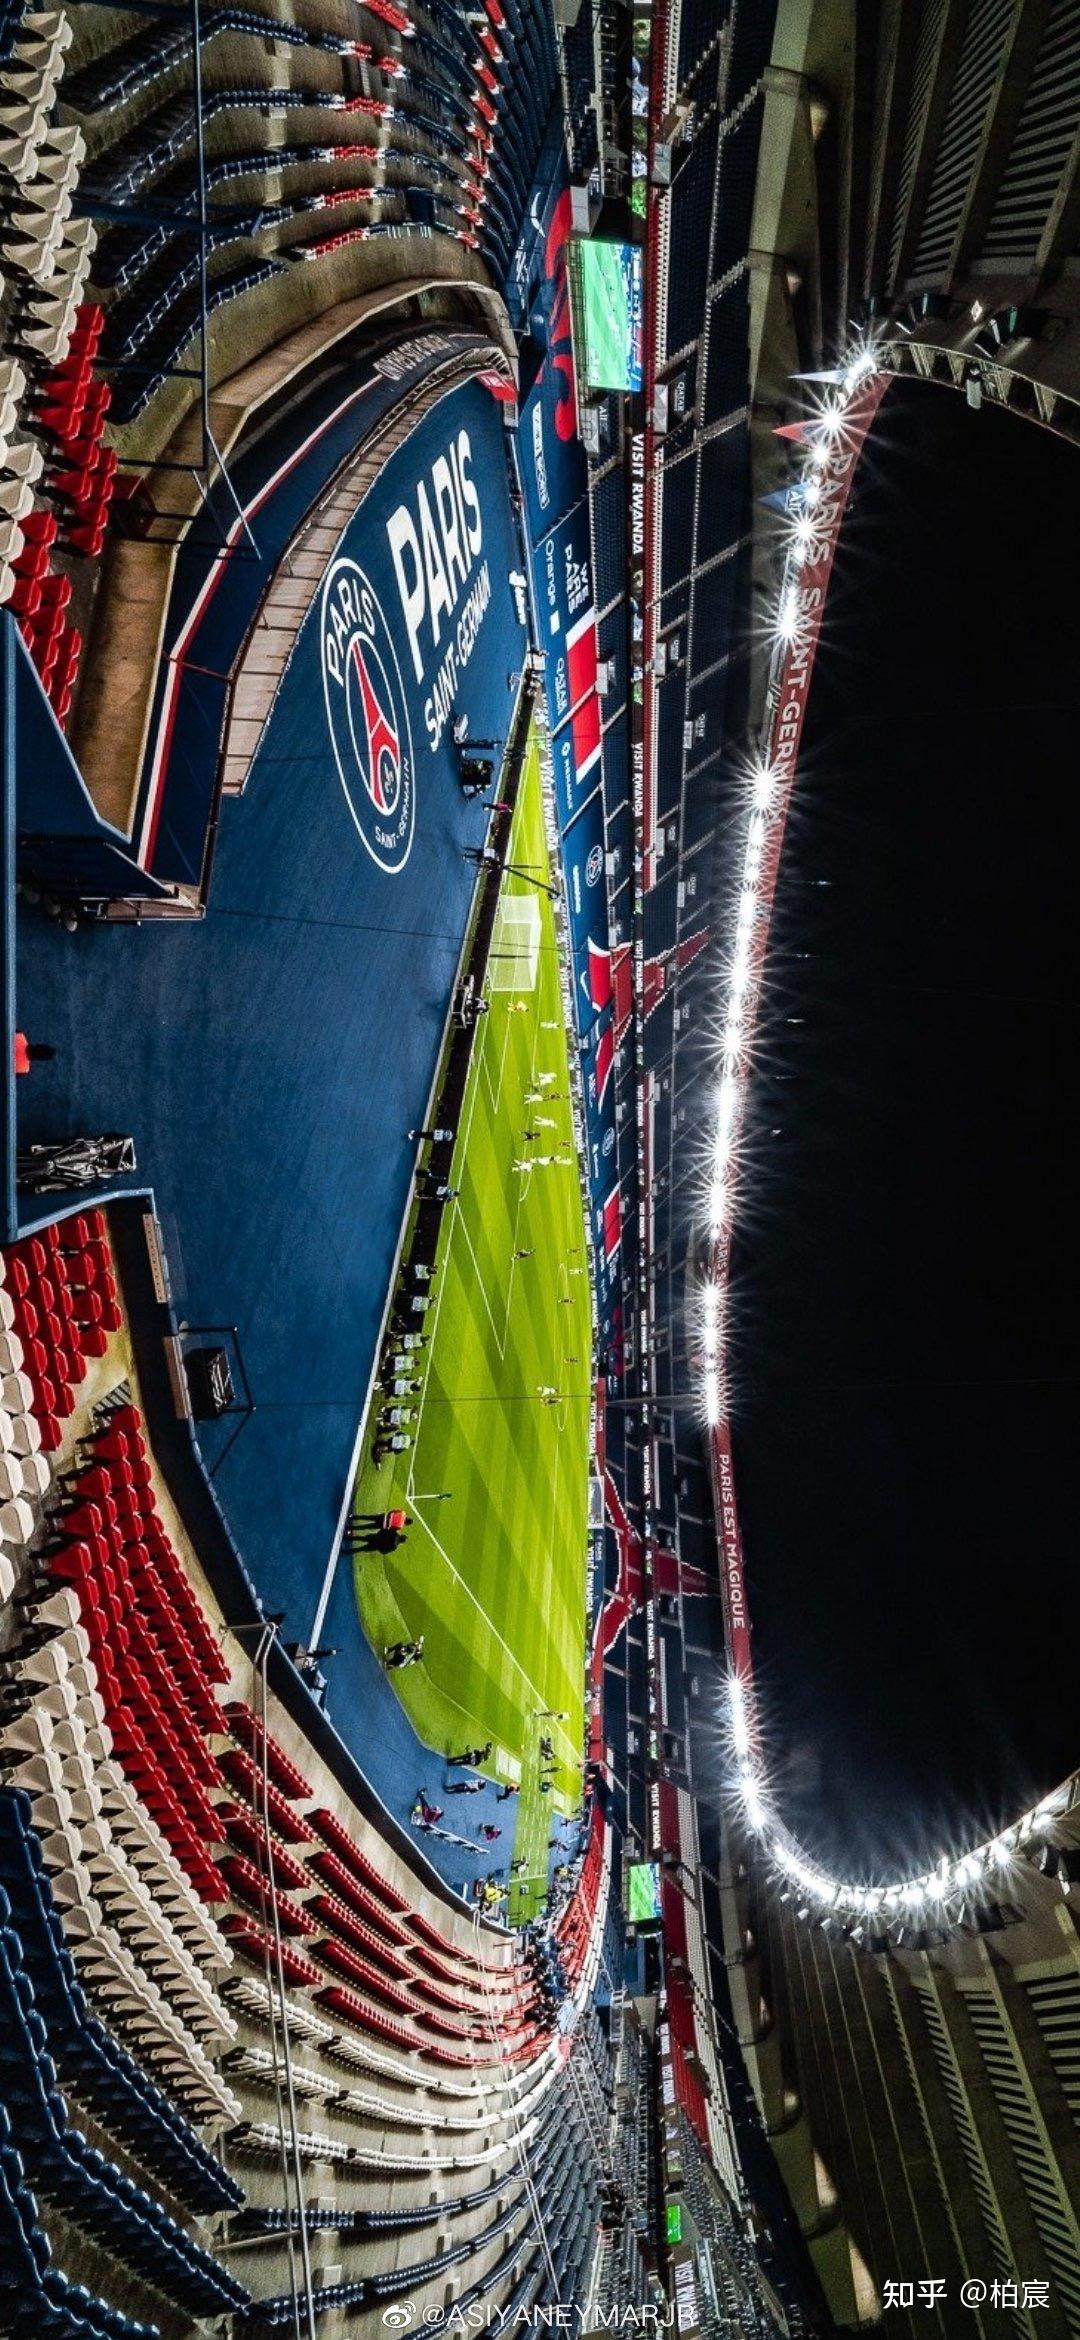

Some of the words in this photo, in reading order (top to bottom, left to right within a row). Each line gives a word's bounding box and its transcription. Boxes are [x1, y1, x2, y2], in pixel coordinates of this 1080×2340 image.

[632, 433, 644, 477] VISIT
[631, 483, 644, 555] RWANDA
[805, 453, 854, 566] PARIS
[386, 430, 482, 684] PARIS
[546, 539, 556, 606] Orange
[565, 543, 575, 614] PARIS
[327, 577, 376, 687] PARIS
[424, 560, 491, 752] SAINT-GERMAIN
[765, 587, 821, 827] SAINT-GERMN
[539, 759, 554, 794] VISIT
[633, 742, 643, 770] VISIT
[632, 773, 643, 817] RWANDA
[543, 798, 558, 851] RWANDA
[634, 939, 643, 959] VISIT
[719, 1454, 732, 1503] PARIS
[723, 1507, 736, 1538] EST
[586, 1571, 594, 1614] RWANDA
[726, 1543, 745, 1629] MAGIQUE
[646, 1599, 654, 1621] VISIT
[647, 1622, 655, 1660] RWANDA
[651, 1782, 660, 1807] VISIT
[652, 1809, 661, 1850] RWANDA
[674, 2260, 694, 2286] VISIT
